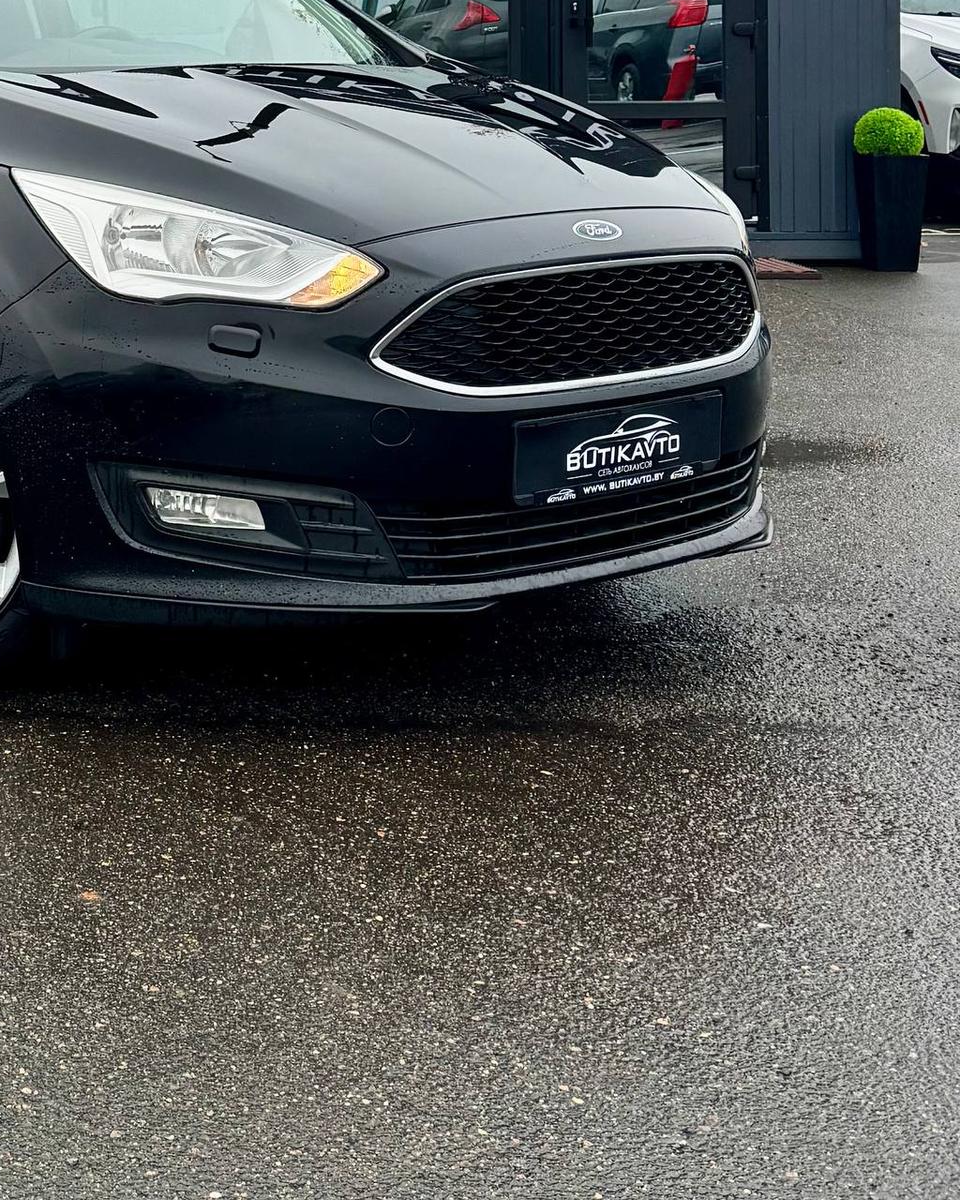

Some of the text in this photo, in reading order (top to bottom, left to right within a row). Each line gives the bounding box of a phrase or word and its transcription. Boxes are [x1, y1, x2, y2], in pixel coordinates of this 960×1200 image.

[585, 223, 612, 236] Ford
[566, 434, 680, 472] BUTIKAVTO
[609, 472, 665, 490] BUTIKAVTO.BY
